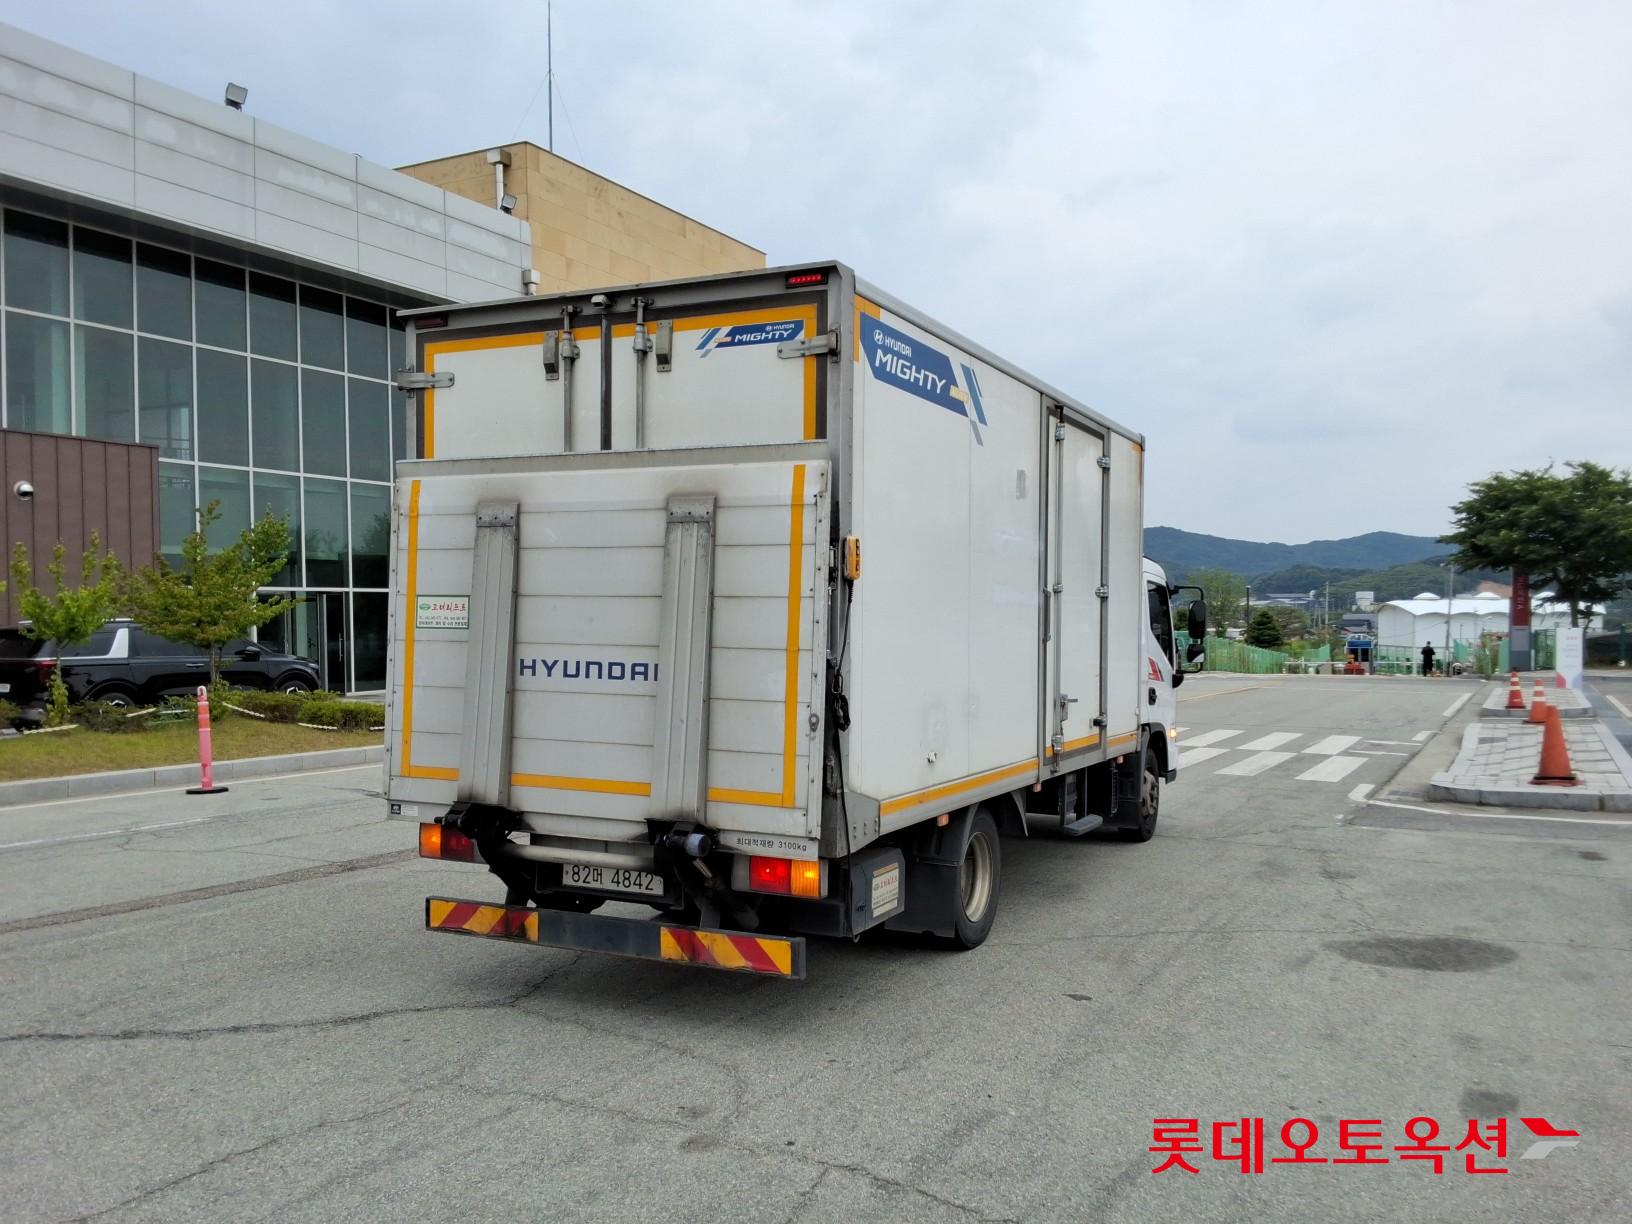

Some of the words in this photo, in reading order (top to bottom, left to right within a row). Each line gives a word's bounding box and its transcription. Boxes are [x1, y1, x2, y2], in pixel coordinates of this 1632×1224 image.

[735, 329, 792, 343] MIGHTY
[773, 323, 795, 331] HYUNDAI
[884, 336, 912, 358] HYUNDAI
[875, 349, 946, 394] MIGHTY
[519, 658, 659, 682] HYUNDAI
[778, 841, 807, 852] 3100kg
[571, 864, 603, 885] 82머
[611, 868, 654, 891] 4842
